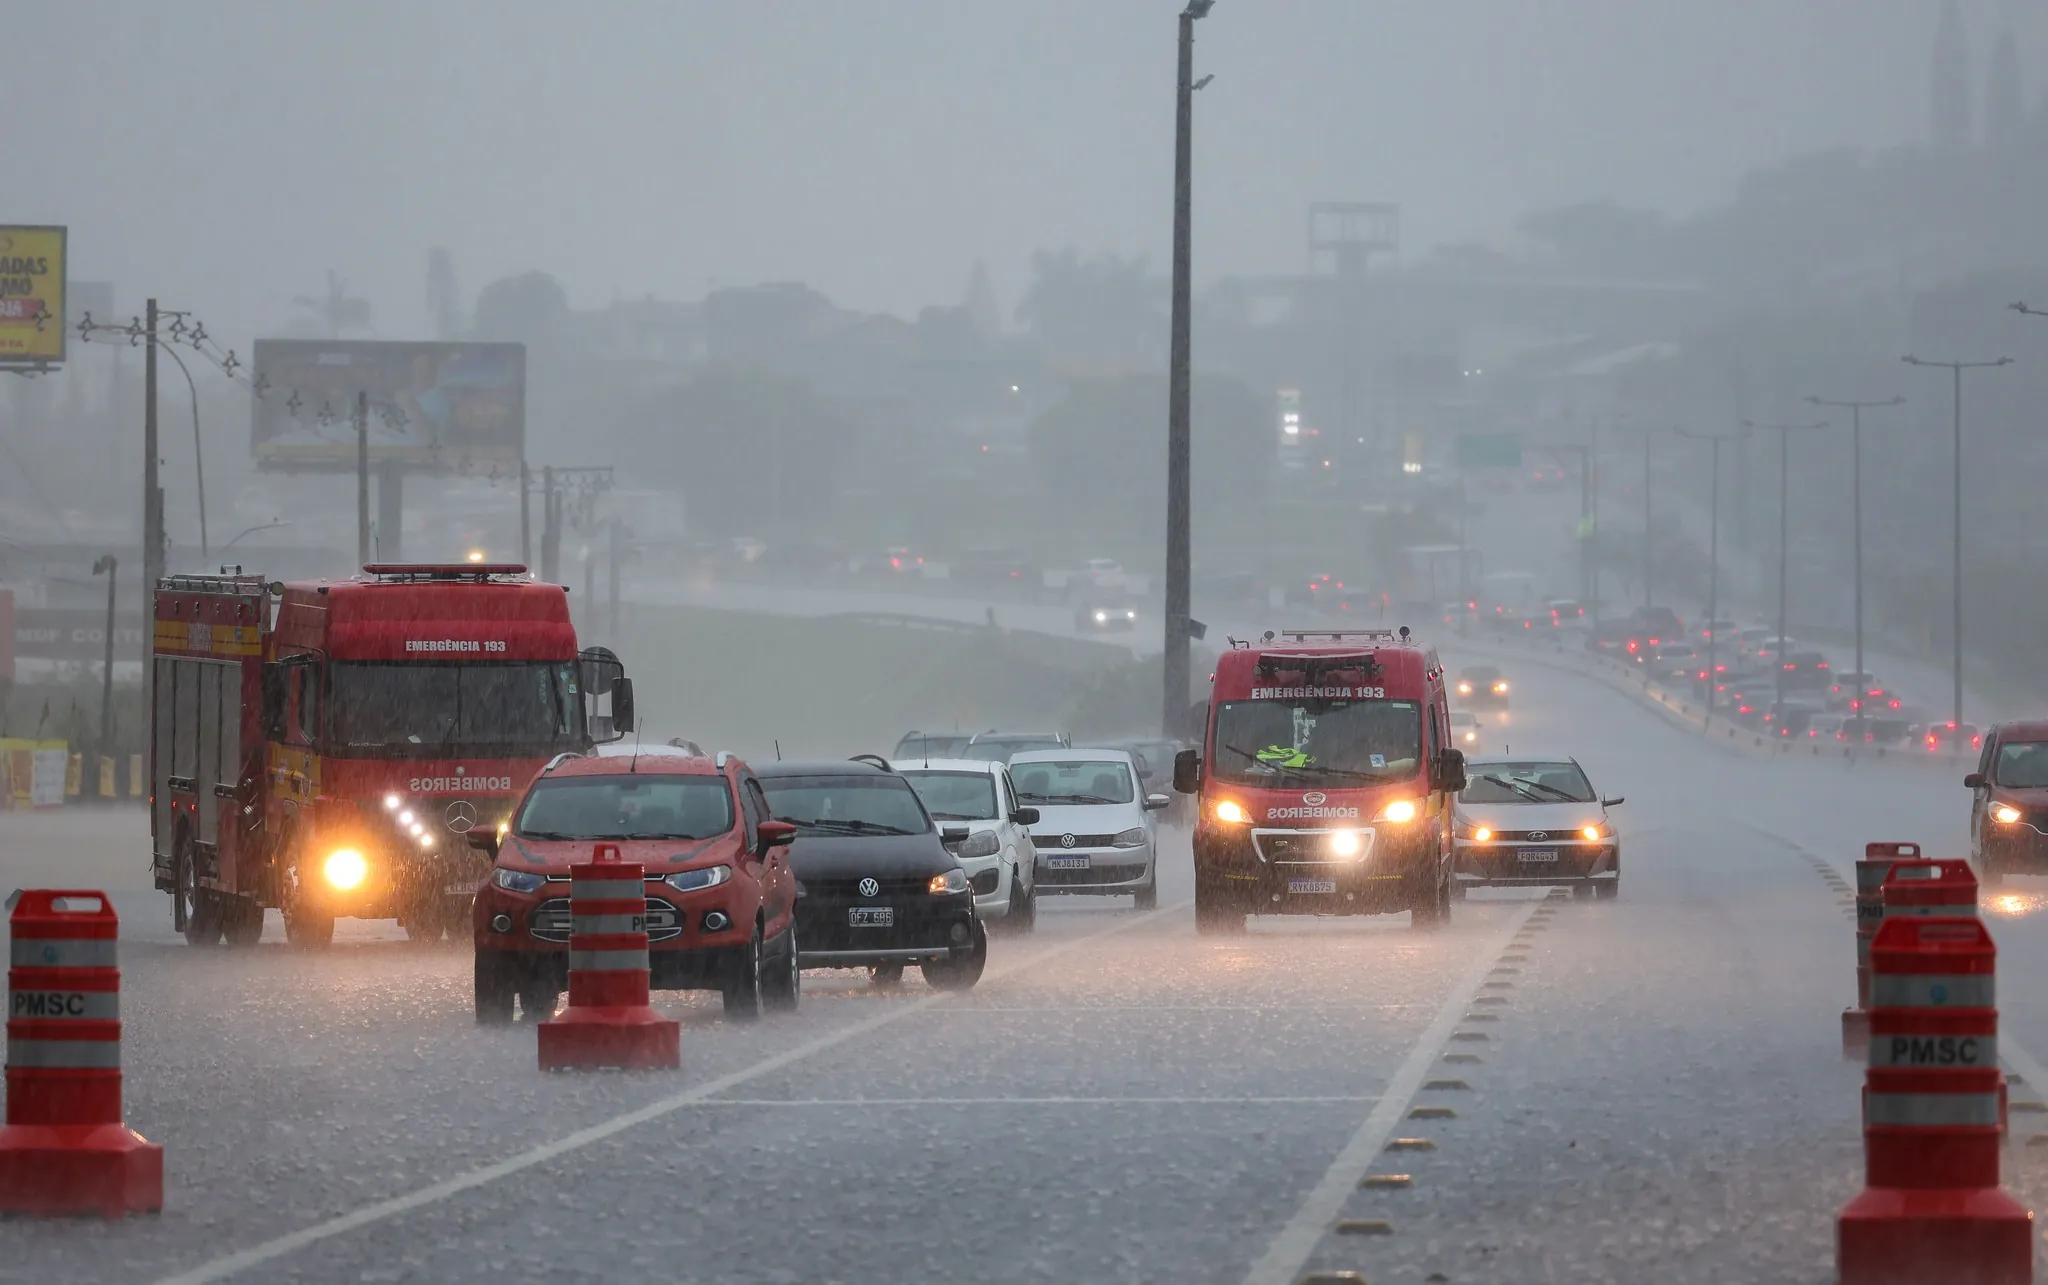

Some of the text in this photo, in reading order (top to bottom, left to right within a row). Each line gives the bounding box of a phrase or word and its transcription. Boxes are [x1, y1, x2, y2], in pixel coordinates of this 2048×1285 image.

[405, 639, 506, 652] EMERGÊNCIA 193
[1251, 685, 1385, 699] EMERGÊNCIA 193
[14, 993, 85, 1016] PMSC
[1891, 1038, 1978, 1065] PMSC
